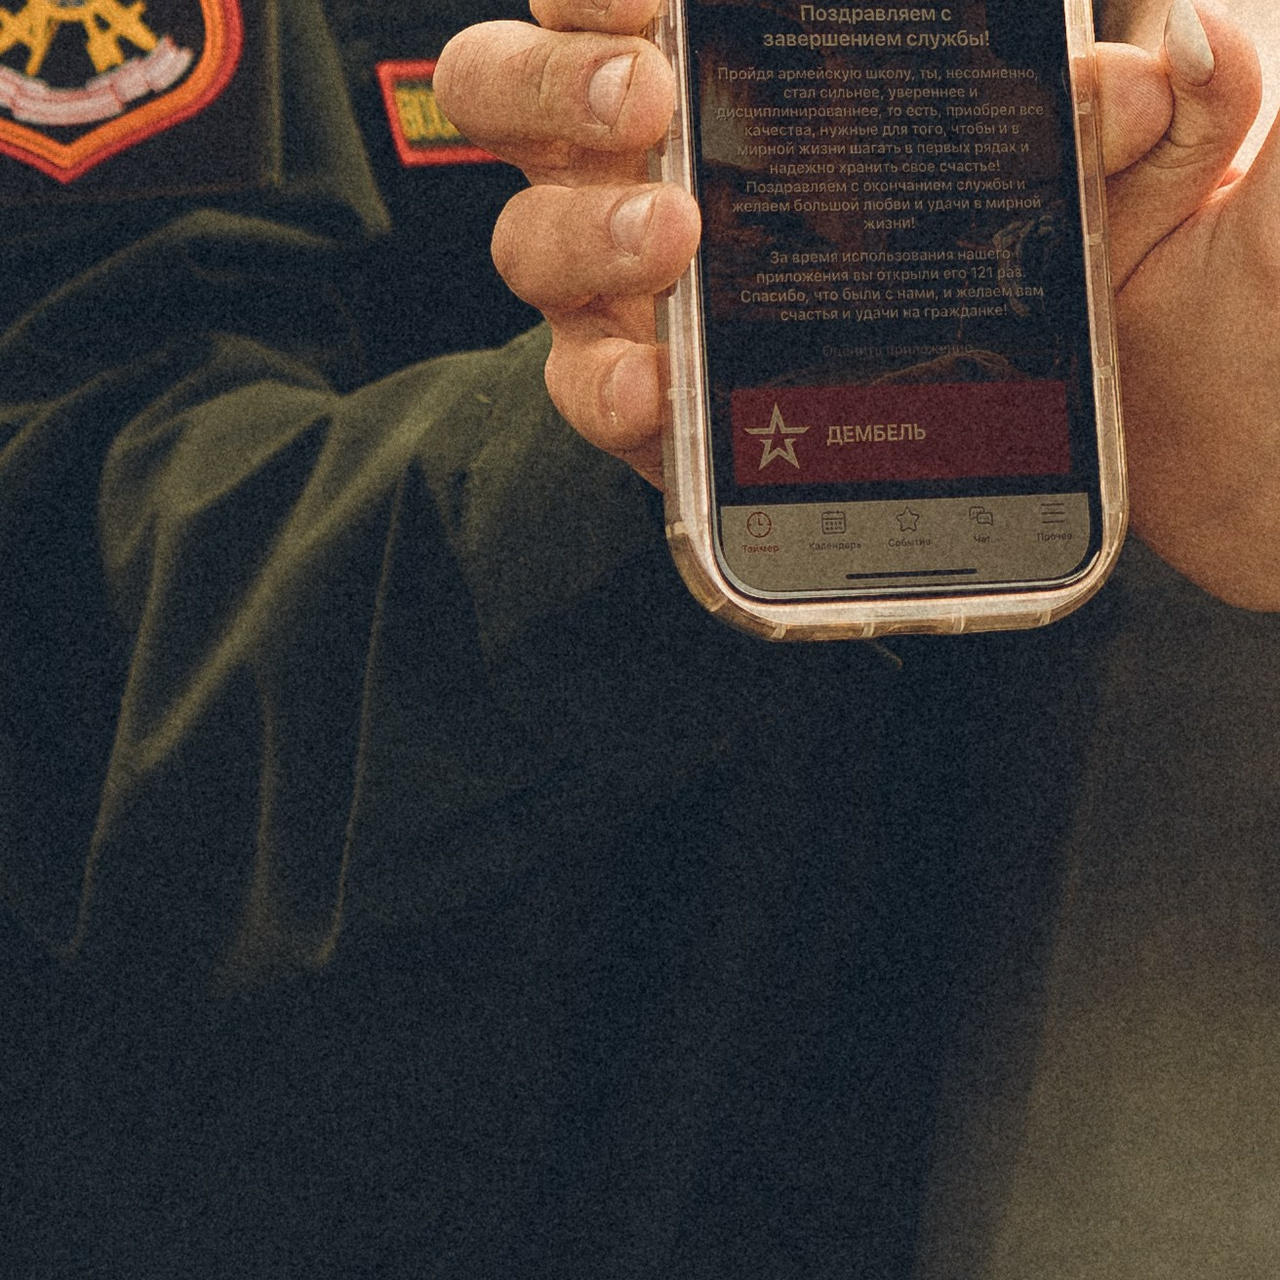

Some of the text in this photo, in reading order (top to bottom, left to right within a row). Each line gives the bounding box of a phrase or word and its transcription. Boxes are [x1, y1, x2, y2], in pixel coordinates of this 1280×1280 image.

[800, 4, 951, 25] Поздравляем с
[763, 30, 990, 49] завершением службы!
[717, 67, 1038, 83] Пройдя армейскую школу, ты, несомненно,
[784, 87, 978, 103] стал сильнее, увереннее и
[716, 102, 1044, 121] дисциплинированнее, то есть, приобрел все
[745, 125, 816, 138] качества,
[820, 124, 878, 138] нужные
[882, 124, 908, 138] для
[912, 124, 948, 137] того,
[951, 122, 995, 135] чтобы
[998, 124, 1007, 134] и
[737, 142, 1029, 157] мирной жизни шагать в первых рядах и
[769, 159, 1000, 176] надежно хранить свое счастье!
[746, 178, 1026, 196] Поздравляем с окончанием службы и
[732, 195, 1041, 213] желаем большой любви и удачи в мирной
[863, 217, 917, 230] жизни!
[770, 249, 1012, 266] За время использования нашего
[756, 271, 848, 286] приложения
[853, 270, 873, 281] вы
[877, 268, 939, 282] открыли
[943, 269, 967, 280] его
[970, 266, 994, 280] 121
[740, 285, 1044, 305] Спасибо, что были с нами, и желаем вам
[780, 304, 1007, 322] счастья и удачи на гражданке!
[827, 424, 926, 446] ДЕМБЕЛЬ
